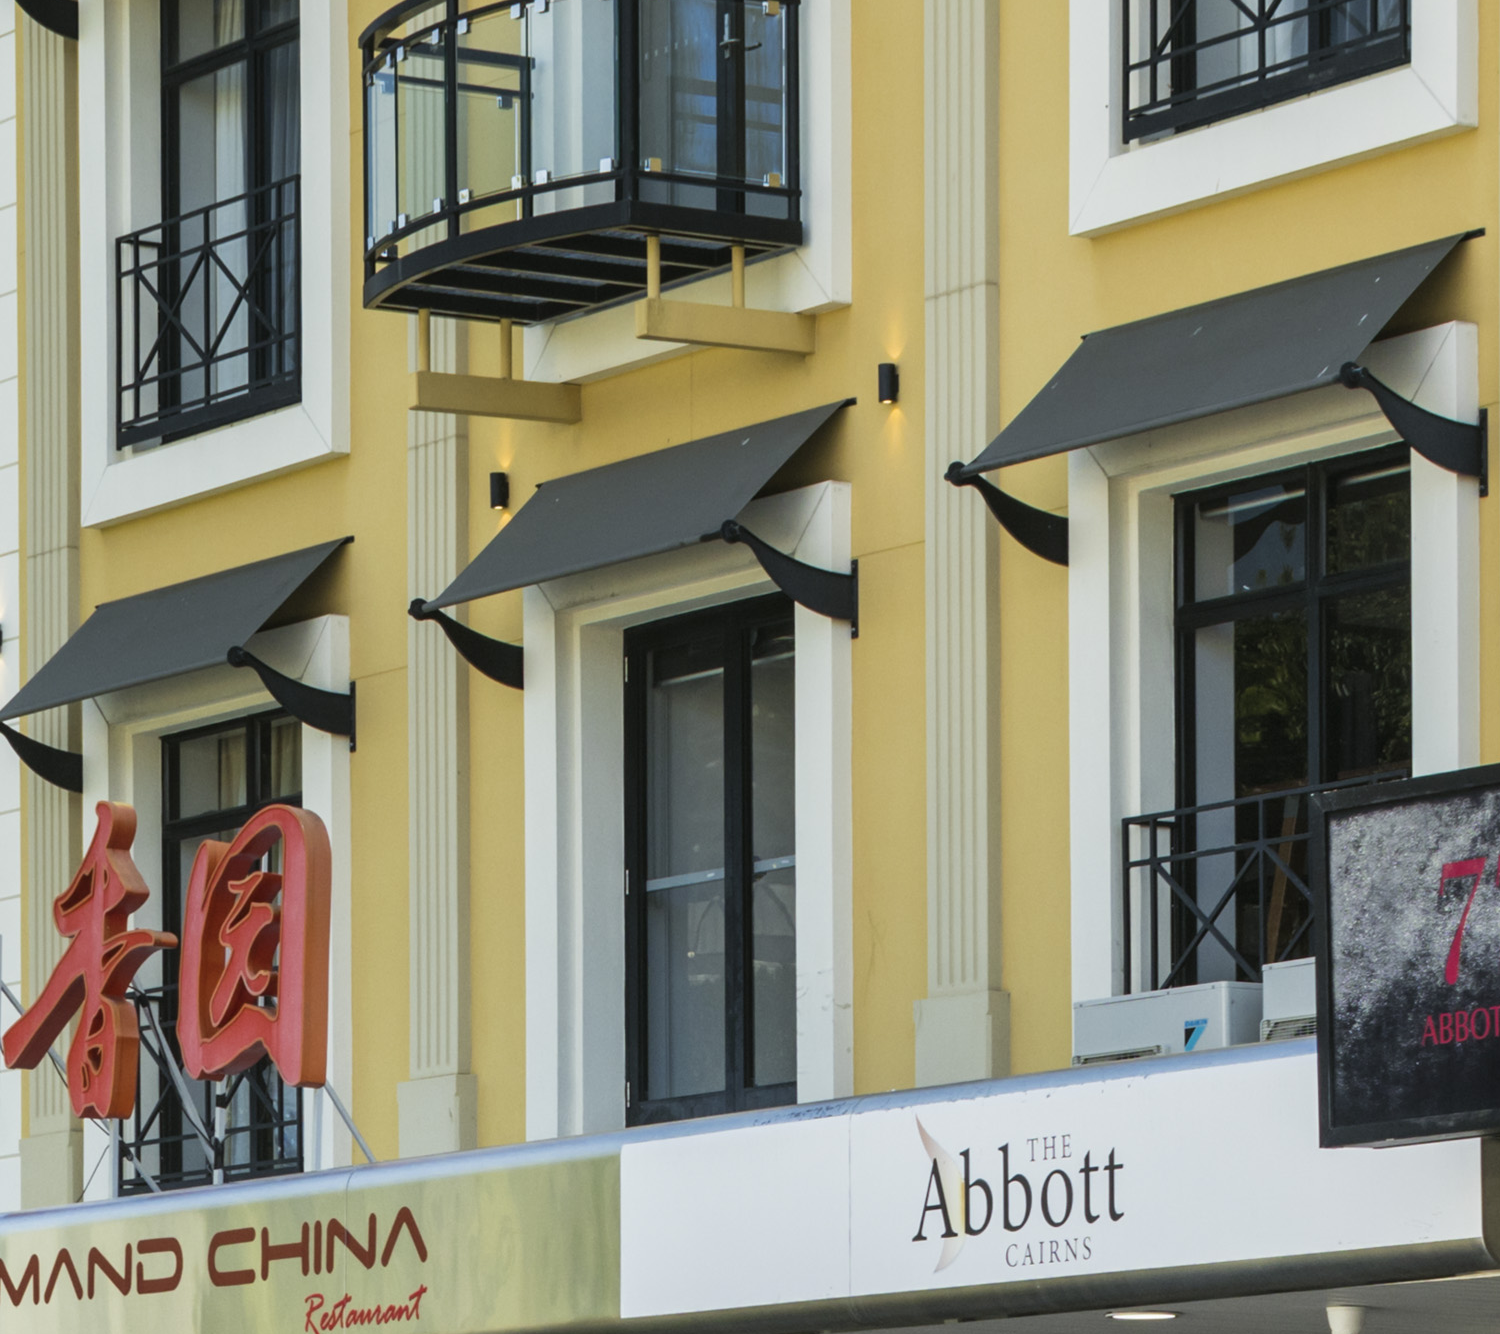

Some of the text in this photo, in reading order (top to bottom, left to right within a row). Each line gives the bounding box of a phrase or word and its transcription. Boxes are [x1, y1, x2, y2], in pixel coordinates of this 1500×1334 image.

[1026, 1133, 1073, 1163] THE
[911, 1141, 1125, 1243] Abbott
[206, 1205, 429, 1288] CHINA
[1004, 1235, 1093, 1268] CAIRNS
